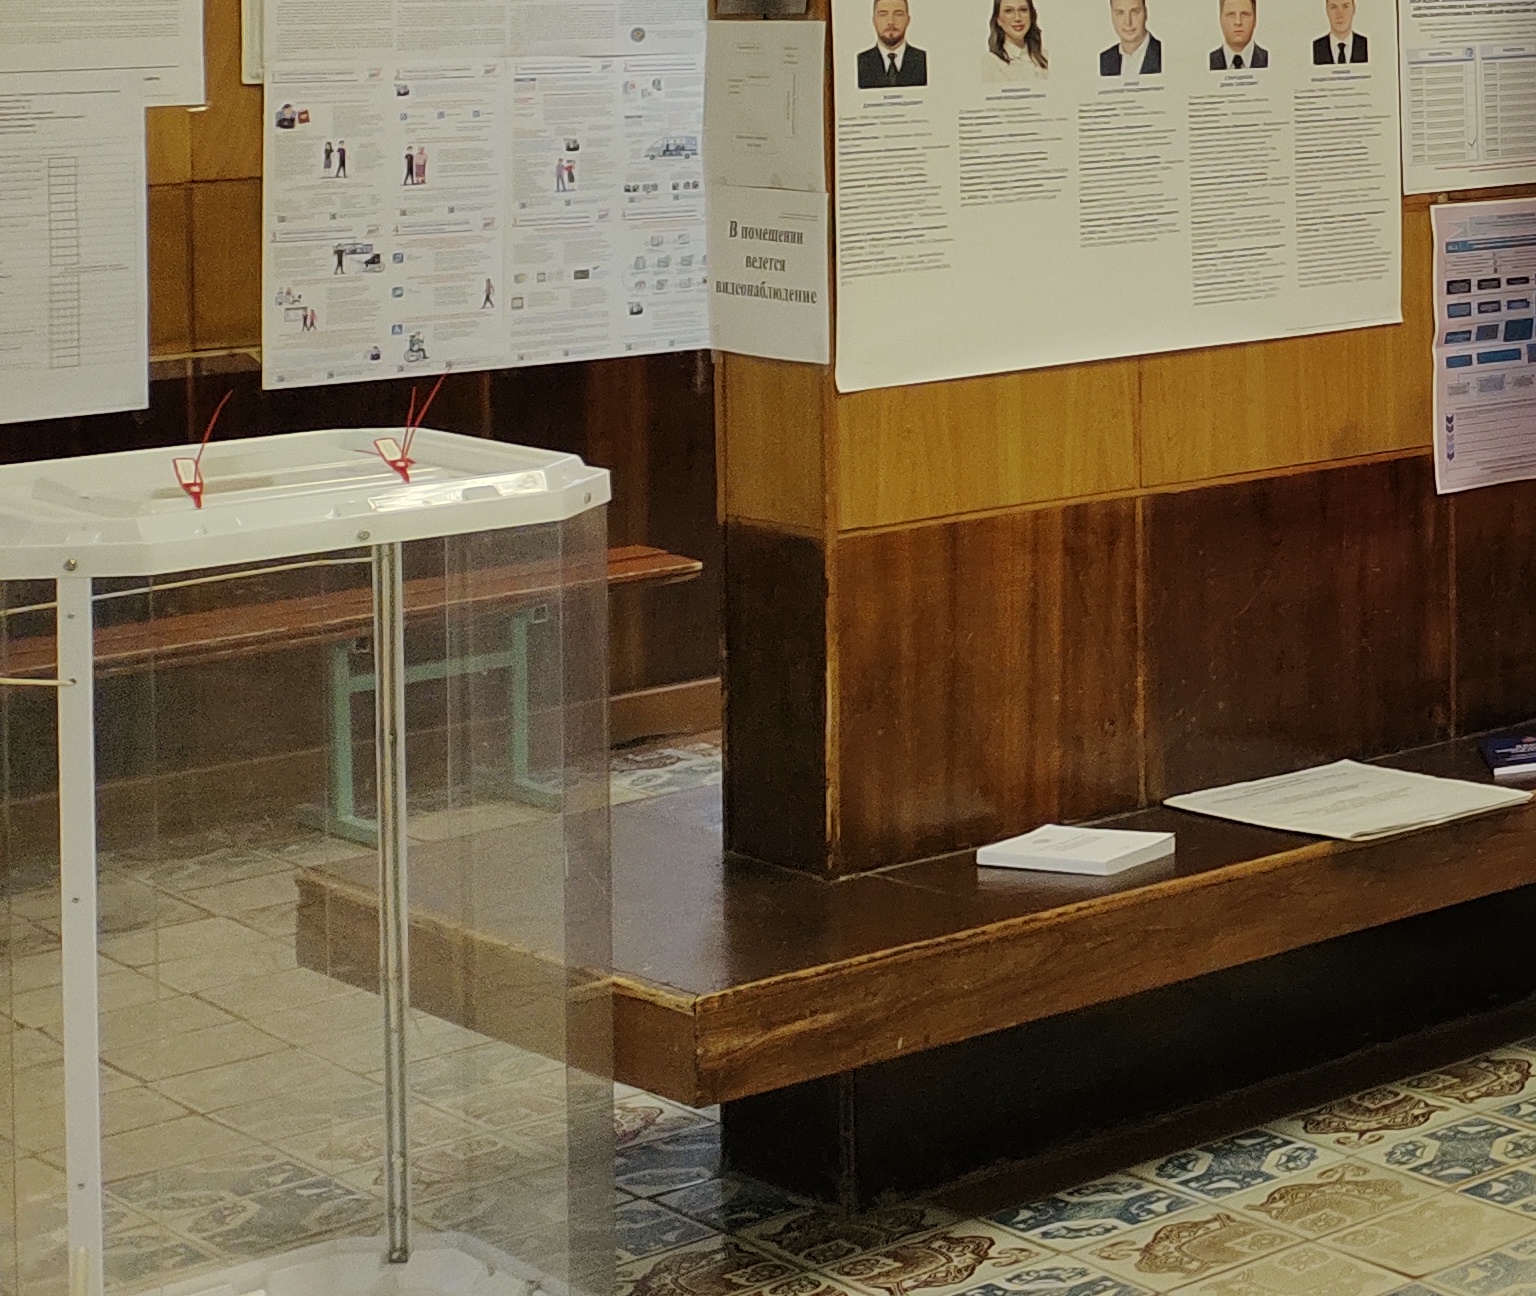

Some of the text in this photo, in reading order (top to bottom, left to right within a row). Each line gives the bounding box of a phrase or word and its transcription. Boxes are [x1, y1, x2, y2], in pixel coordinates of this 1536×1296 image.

[729, 220, 804, 244] В помещении
[745, 256, 785, 272] ведется
[716, 280, 817, 304] видеонаблюдение
